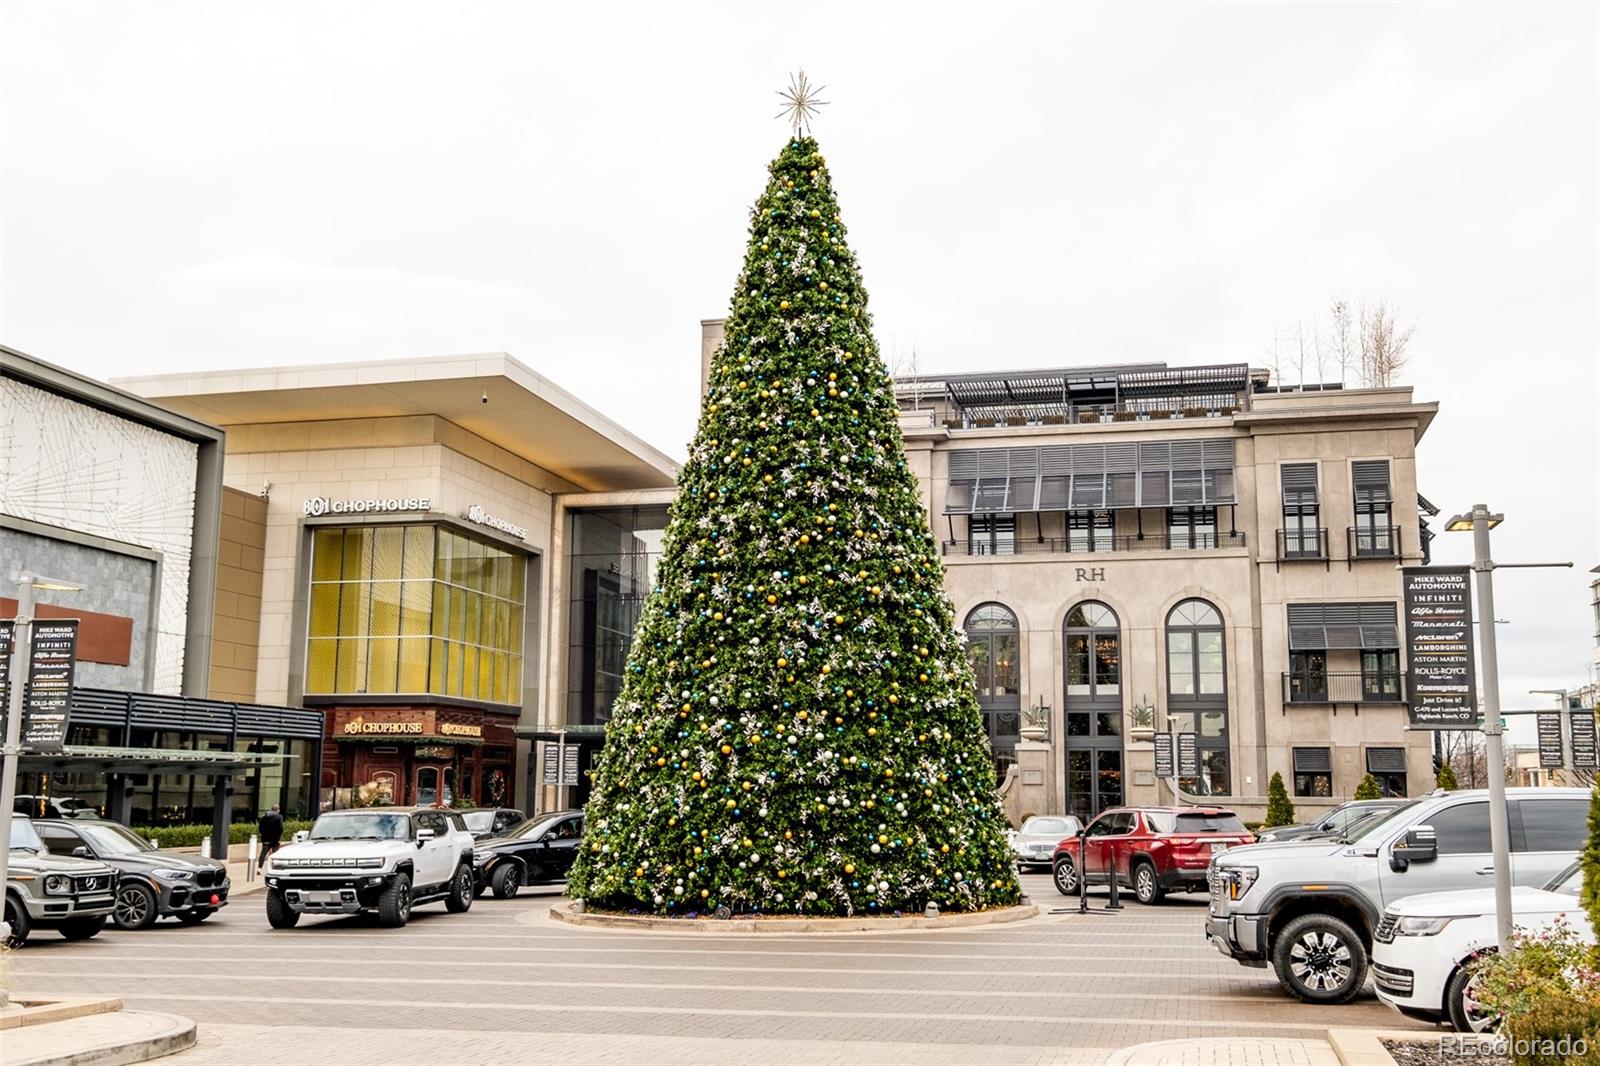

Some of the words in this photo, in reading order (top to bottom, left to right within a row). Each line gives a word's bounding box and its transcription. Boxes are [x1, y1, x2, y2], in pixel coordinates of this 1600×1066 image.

[332, 498, 430, 513] CHOPHOUSE
[1075, 567, 1106, 582] RH
[1414, 667, 1467, 675] ROLLS-ROYCE
[362, 722, 422, 733] CHOPHOUSE
